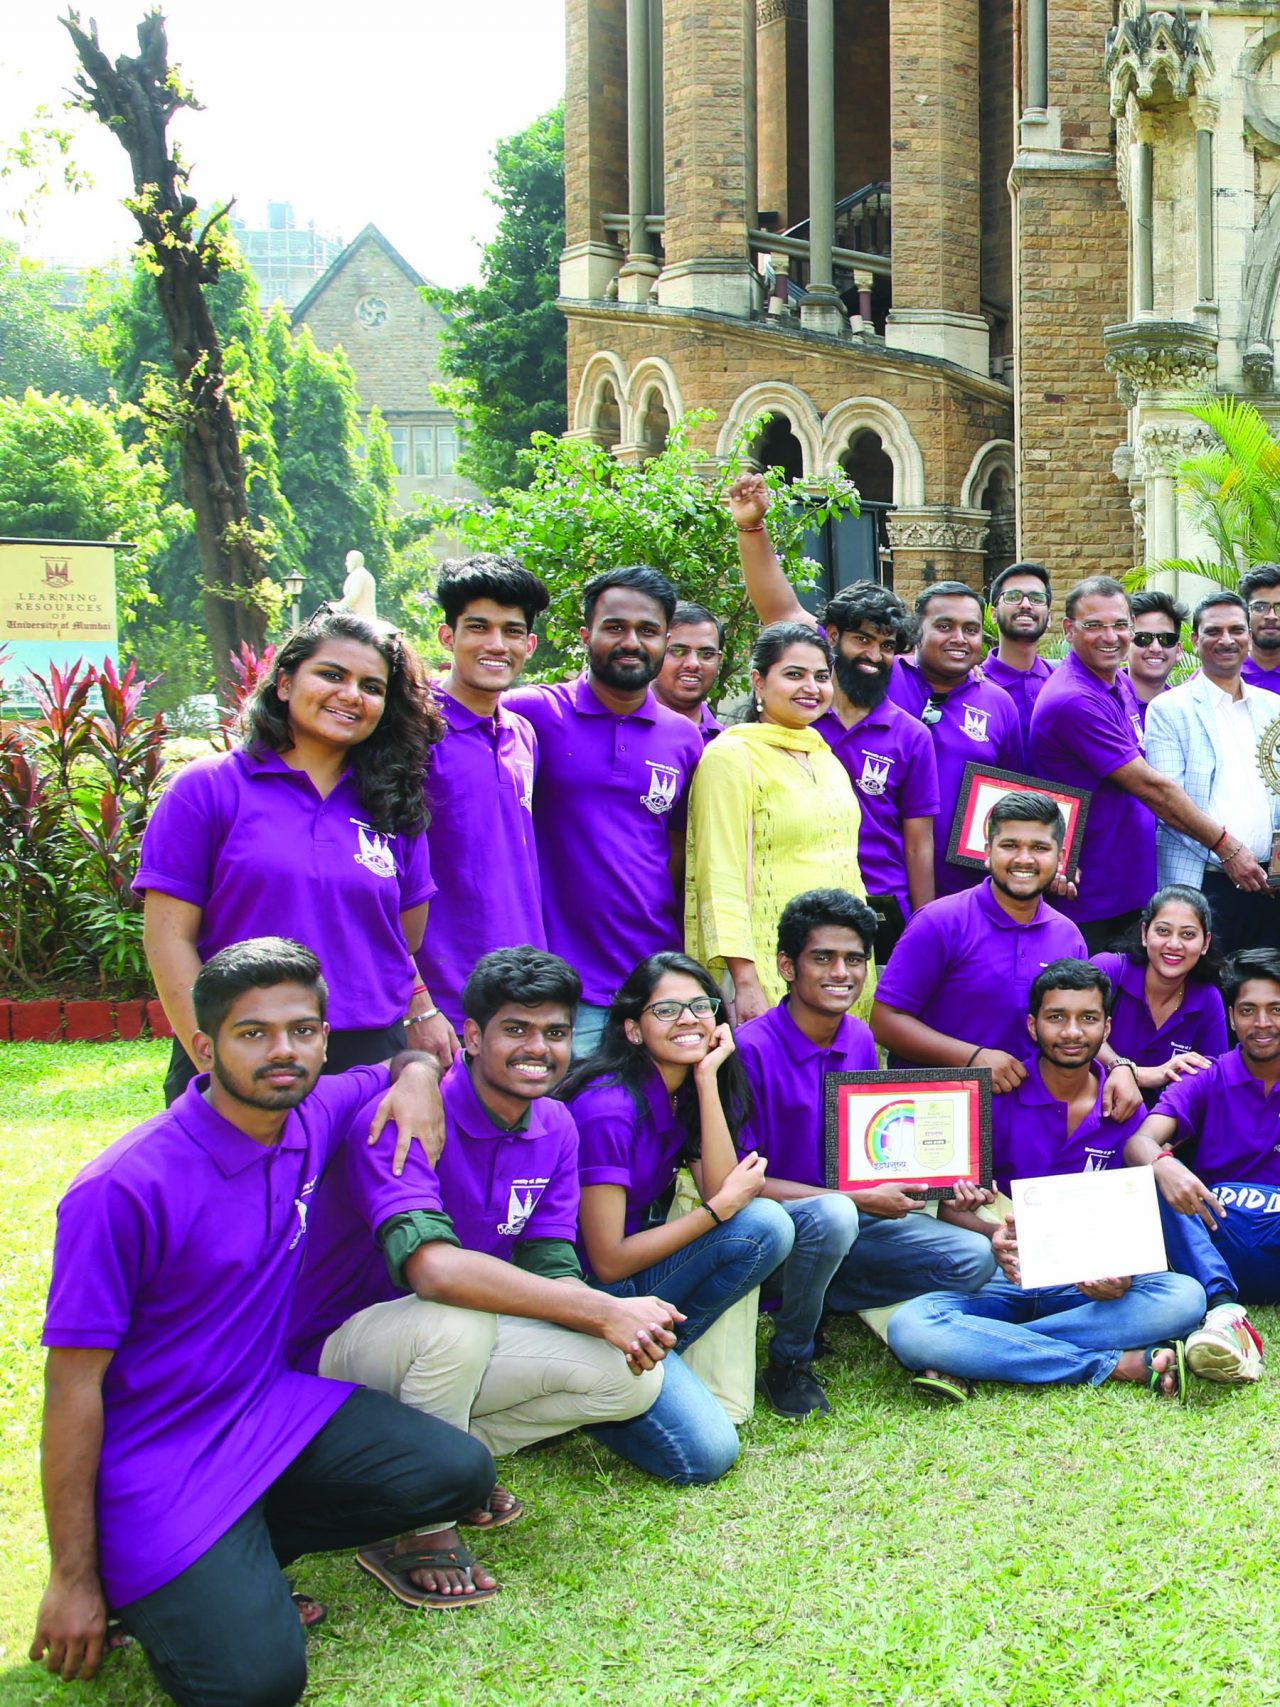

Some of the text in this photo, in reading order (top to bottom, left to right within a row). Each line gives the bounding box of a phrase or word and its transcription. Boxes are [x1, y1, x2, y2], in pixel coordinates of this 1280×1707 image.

[18, 592, 97, 602] LEARNING
[15, 602, 102, 612] RESOURCES
[7, 620, 58, 629] University
[72, 621, 111, 630] Mumbai
